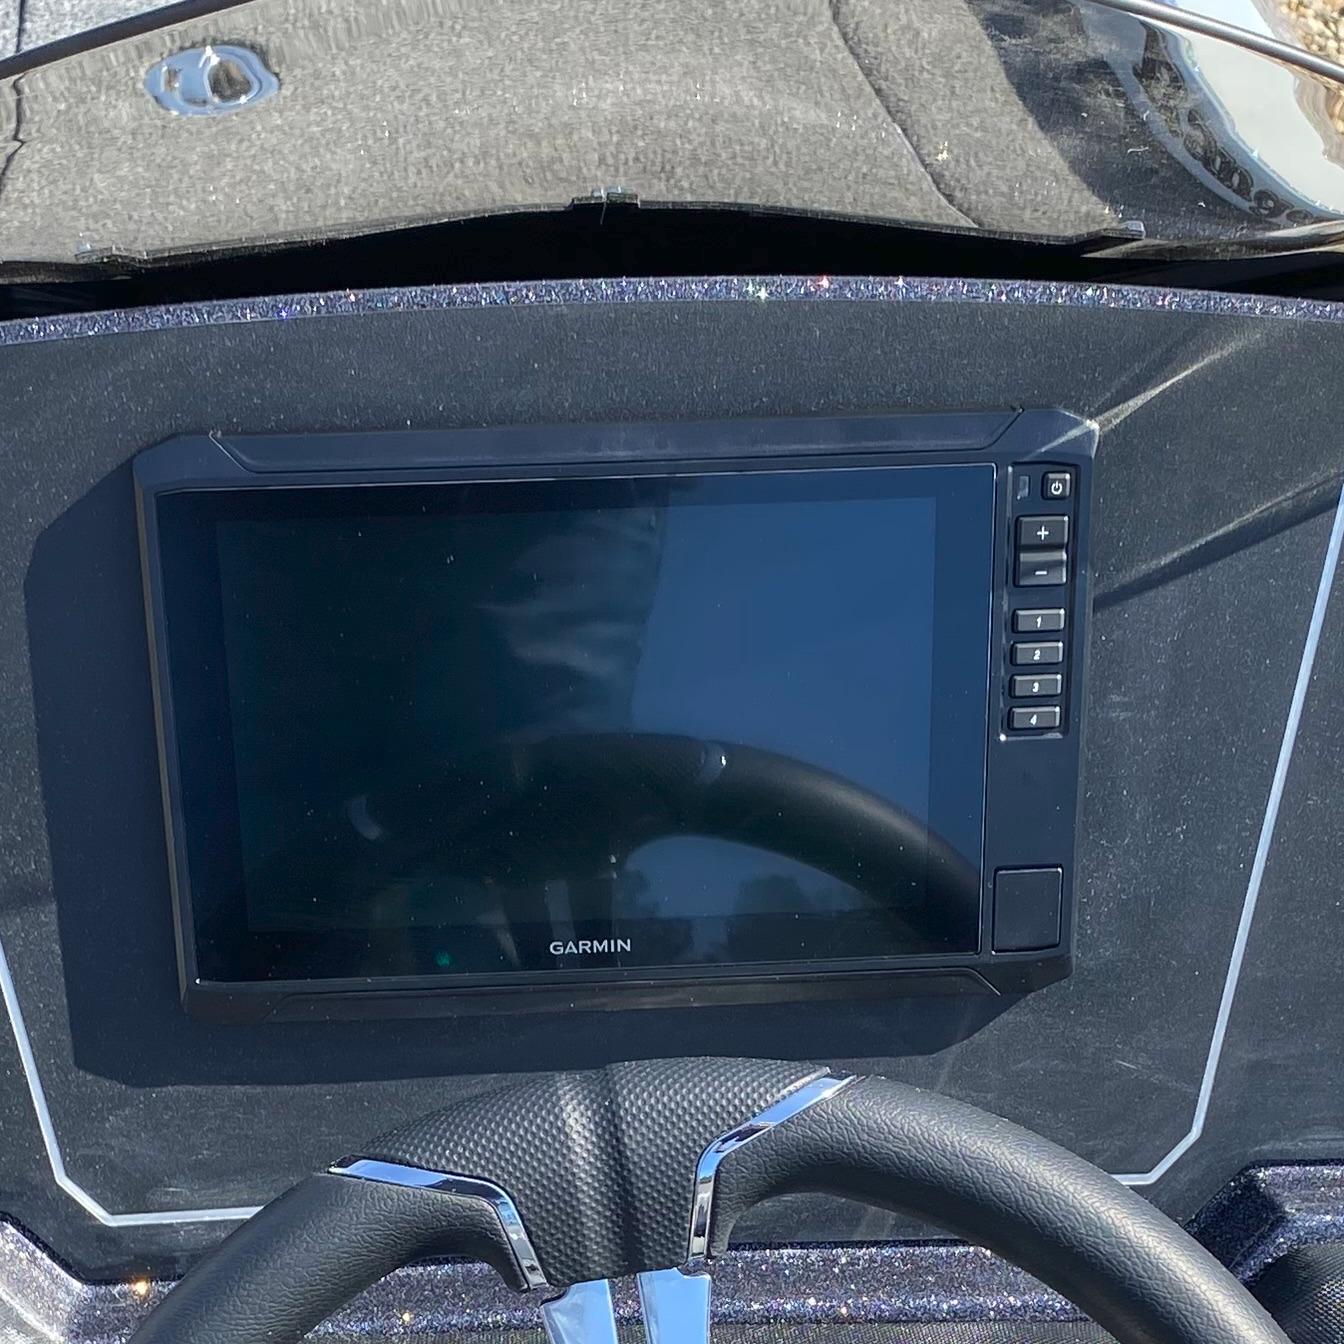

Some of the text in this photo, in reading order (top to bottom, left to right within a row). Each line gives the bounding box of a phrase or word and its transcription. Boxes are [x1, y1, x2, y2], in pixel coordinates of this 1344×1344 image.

[1036, 615, 1042, 628] 1
[1033, 649, 1041, 661] 2
[1032, 681, 1039, 693] 3
[1030, 714, 1037, 725] 4
[549, 938, 631, 955] GARMIN
